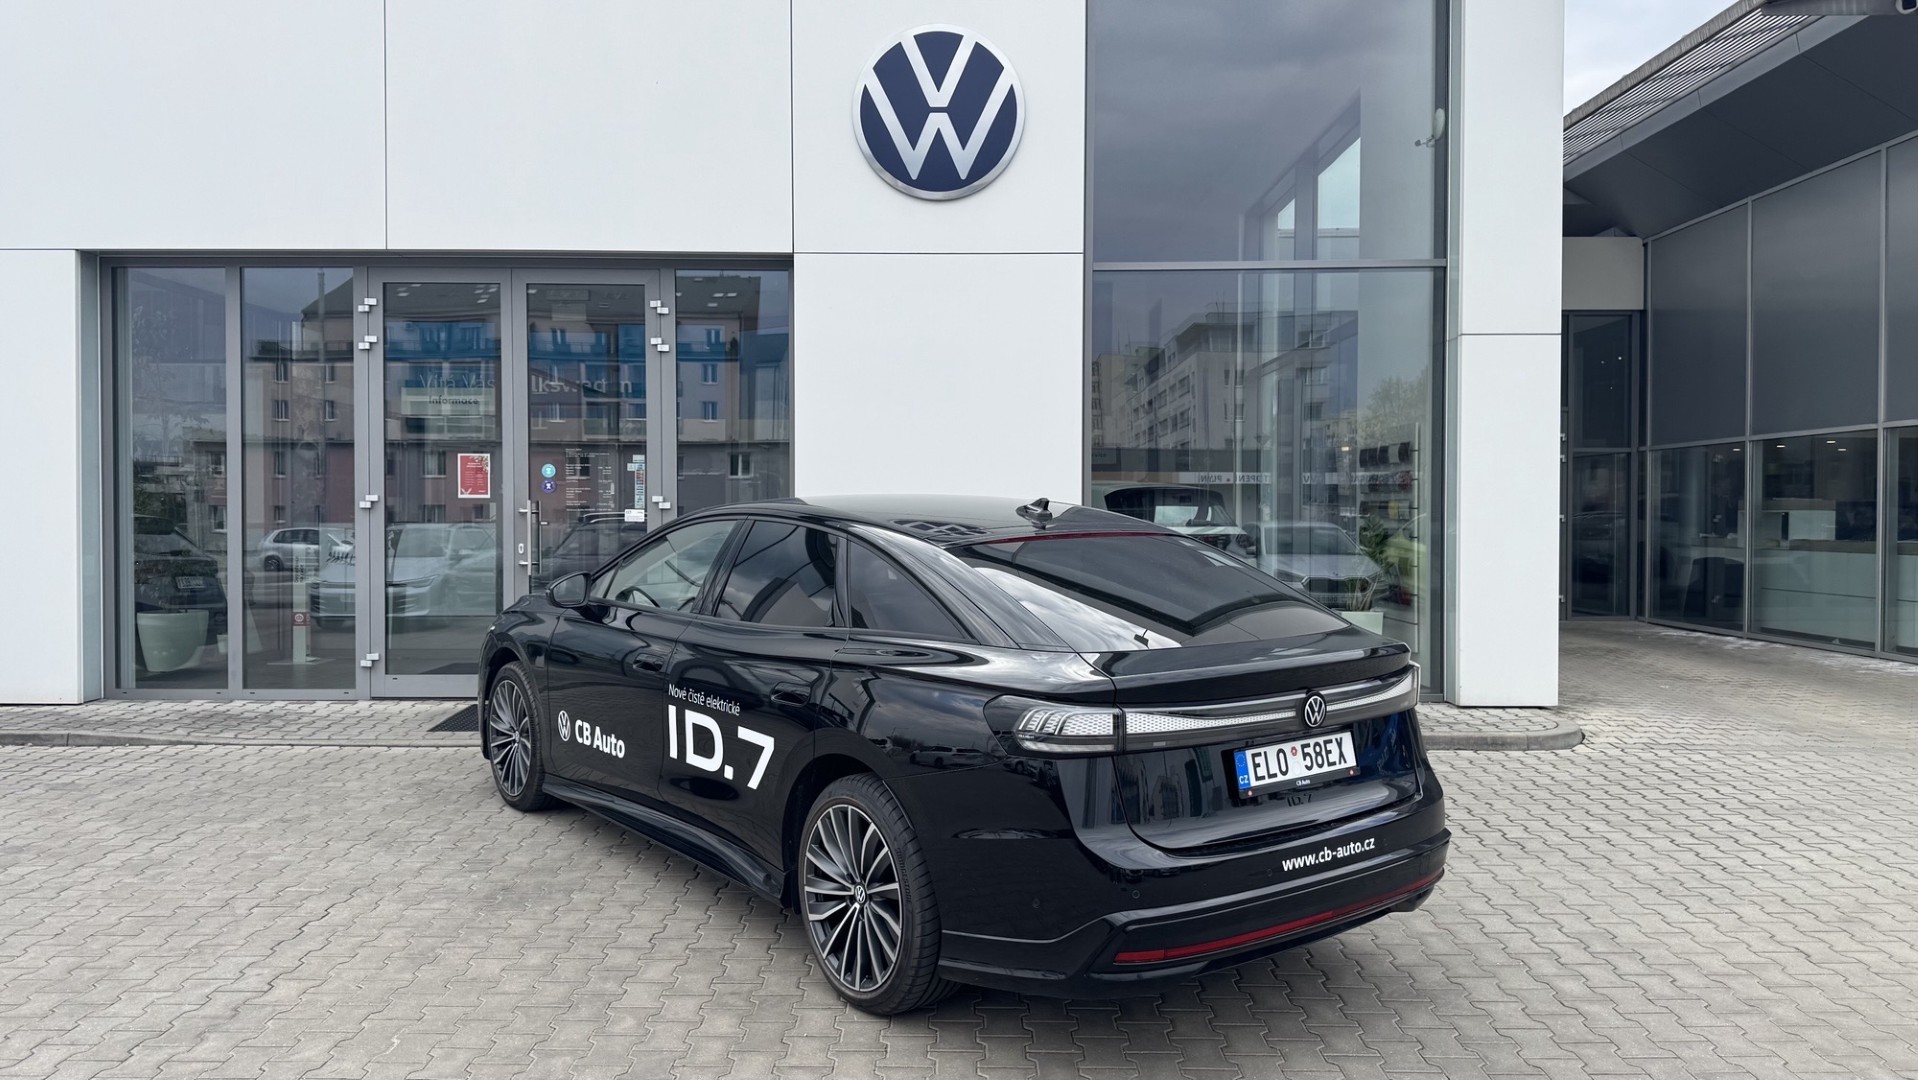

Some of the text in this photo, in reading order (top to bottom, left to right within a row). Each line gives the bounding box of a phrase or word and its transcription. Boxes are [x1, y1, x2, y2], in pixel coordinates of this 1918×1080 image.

[429, 395, 479, 405] Informace
[668, 683, 741, 717] Nové čistě elektrické
[575, 719, 625, 759] CB Auto
[668, 704, 775, 790] ID.7
[1301, 737, 1347, 771] 58EX
[1239, 775, 1249, 785] CZ
[1281, 837, 1376, 872] www.cb-auto.cz
